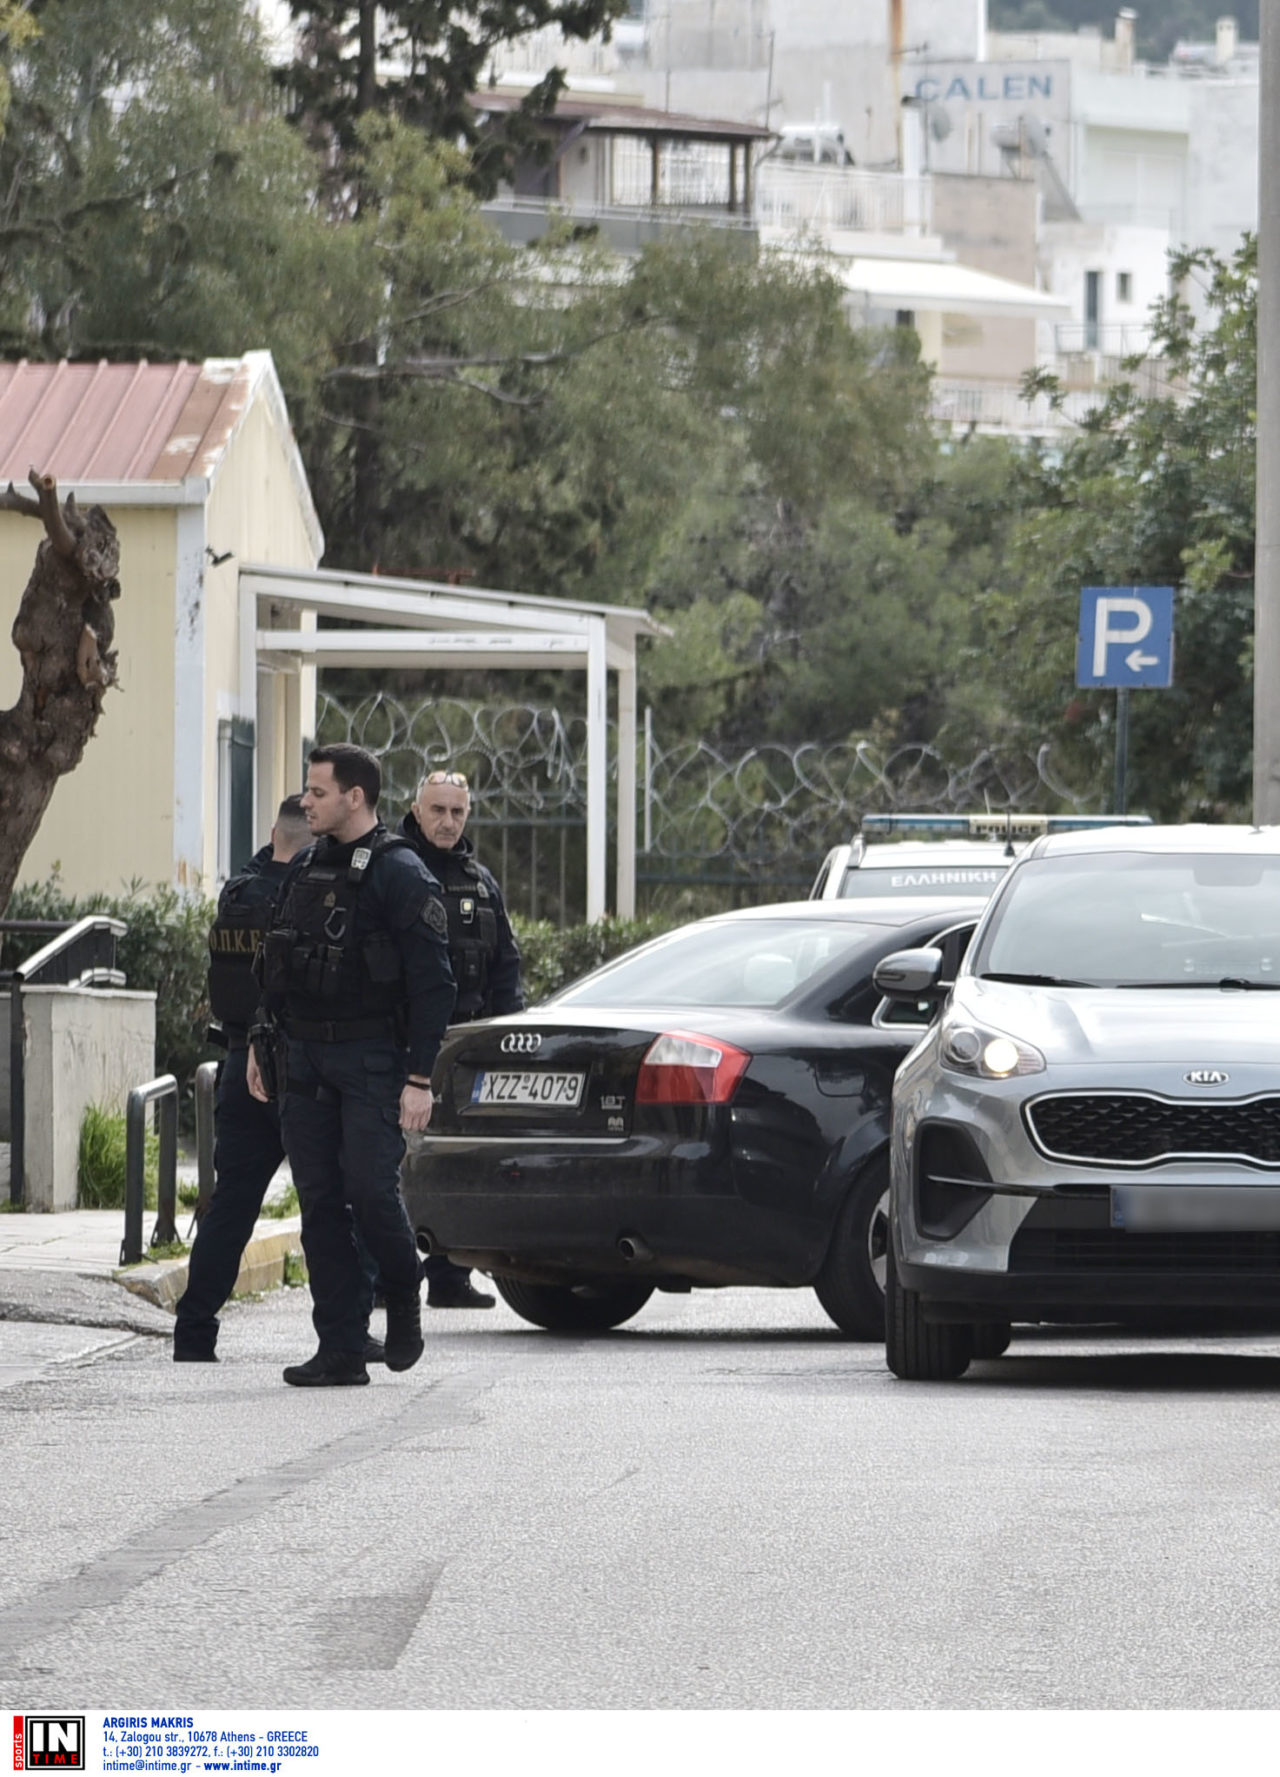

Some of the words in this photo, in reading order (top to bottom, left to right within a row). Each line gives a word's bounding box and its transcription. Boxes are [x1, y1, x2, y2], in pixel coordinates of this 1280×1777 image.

[914, 74, 1053, 101] CALEN
[1092, 597, 1153, 677] P
[891, 871, 997, 888] ΕΛΛΗΝΙΚΗ
[1190, 1071, 1222, 1082] KIA
